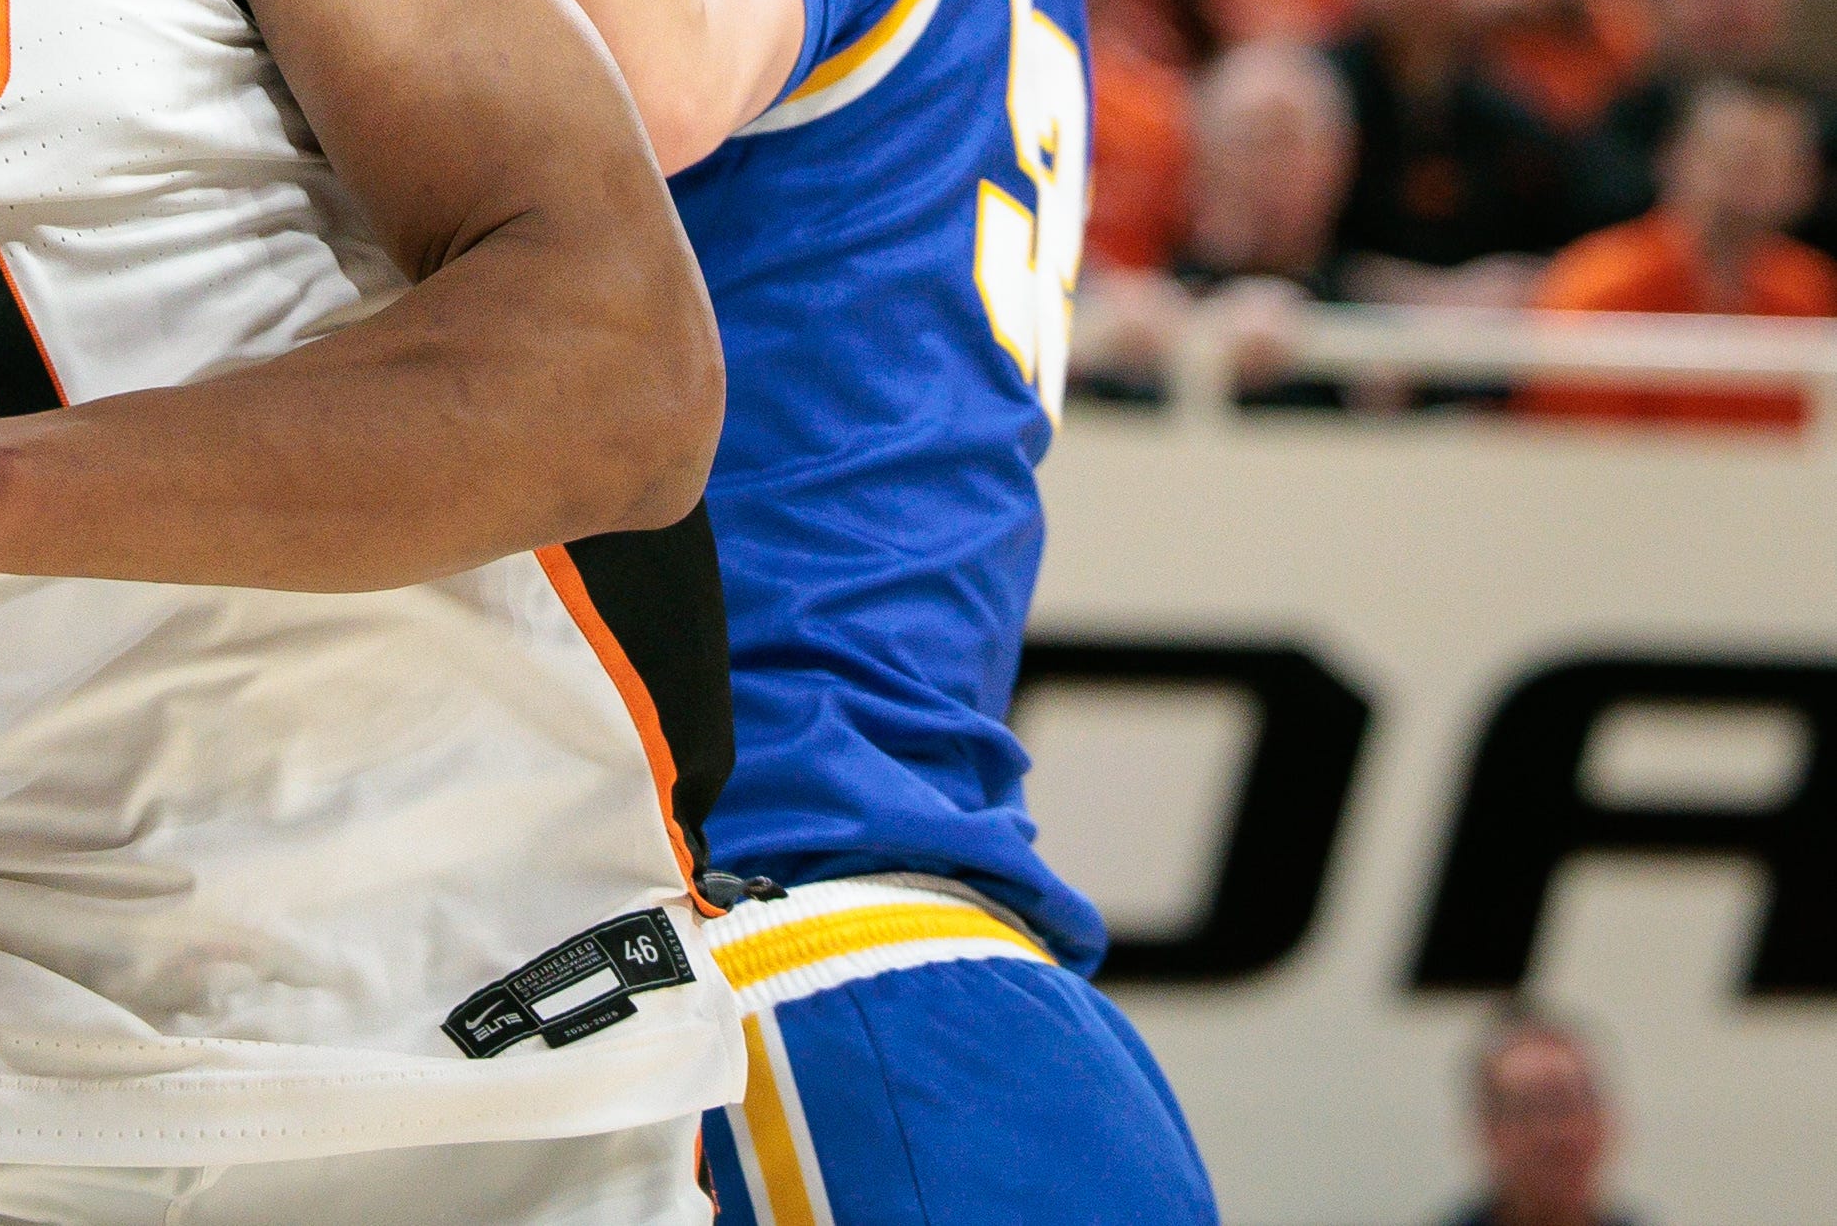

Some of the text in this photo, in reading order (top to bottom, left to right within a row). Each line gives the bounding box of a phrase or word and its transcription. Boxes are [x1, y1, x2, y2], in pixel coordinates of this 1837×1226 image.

[513, 941, 595, 990] ENGINEERED
[624, 934, 659, 966] 46
[472, 1012, 524, 1042] ELITE
